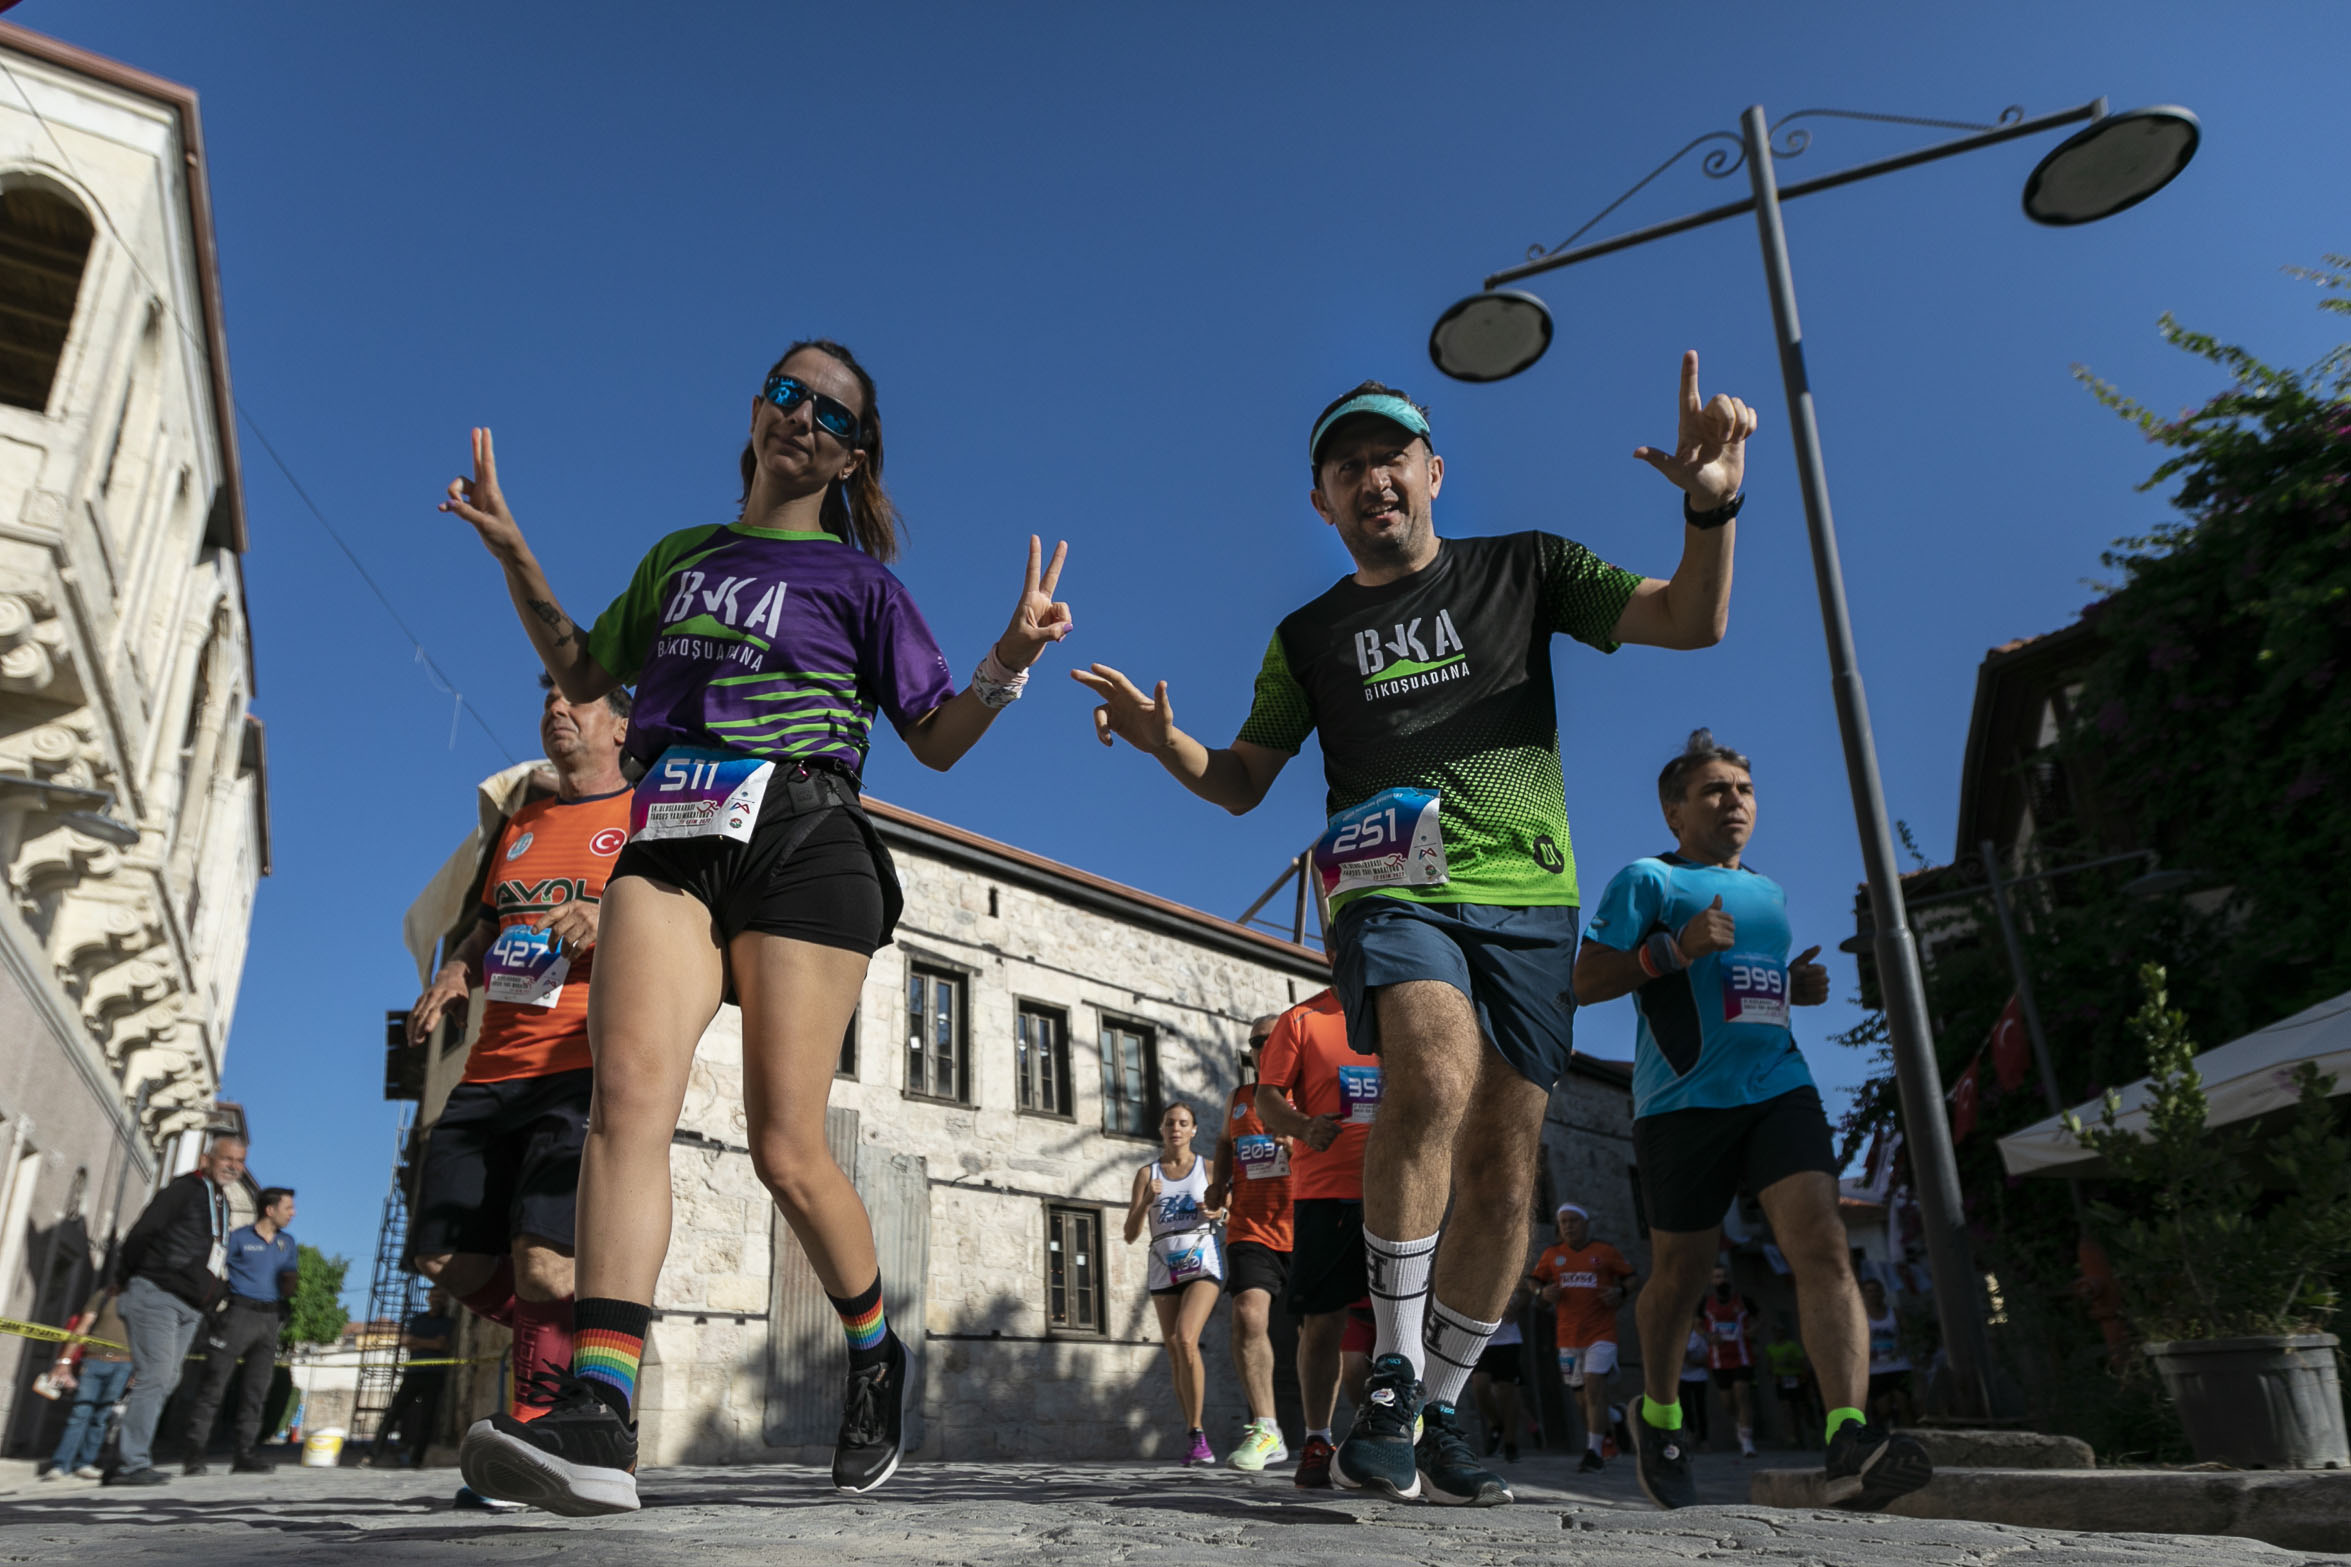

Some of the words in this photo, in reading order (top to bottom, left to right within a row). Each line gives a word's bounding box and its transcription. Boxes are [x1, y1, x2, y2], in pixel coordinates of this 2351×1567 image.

[1365, 662, 1470, 701] BİKOŞUADANA
[659, 758, 719, 791] 511
[1332, 808, 1396, 854] 251
[493, 940, 548, 968] 427
[1732, 965, 1782, 995] 399
[1348, 1077, 1381, 1098] 35
[1241, 1142, 1275, 1160] 203
